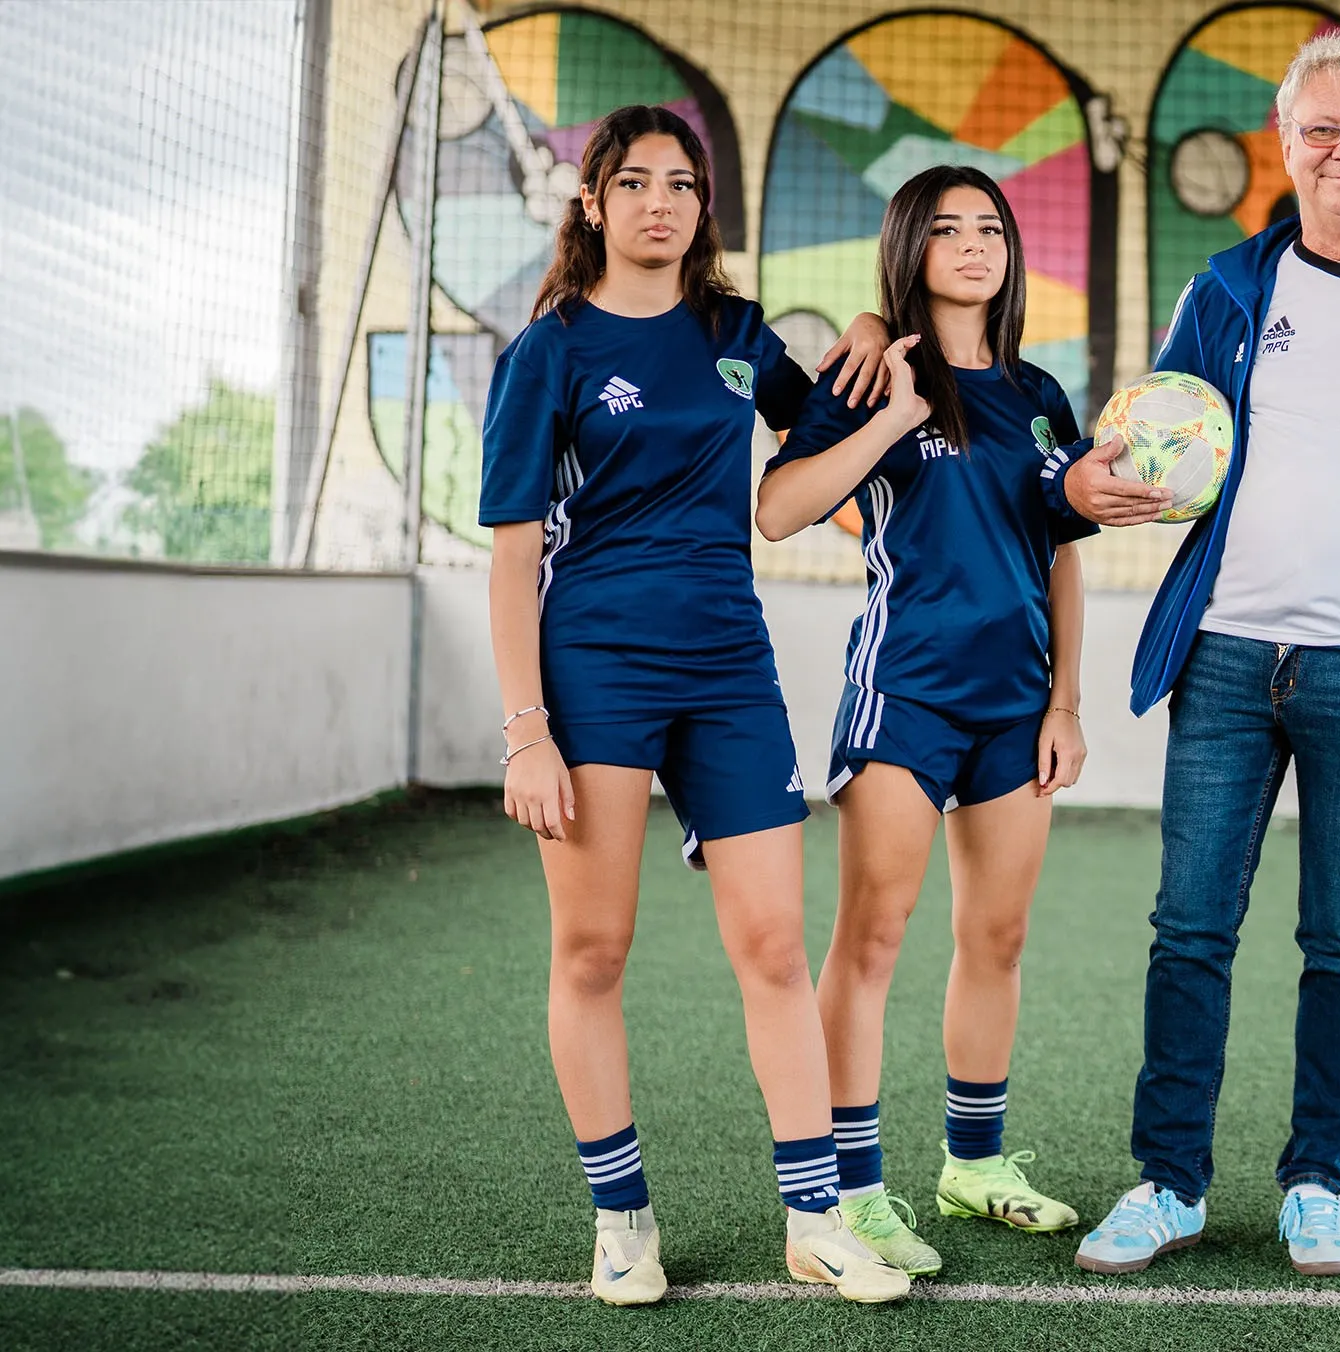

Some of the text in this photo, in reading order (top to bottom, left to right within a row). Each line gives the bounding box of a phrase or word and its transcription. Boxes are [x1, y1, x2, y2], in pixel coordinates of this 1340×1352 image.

[1262, 329, 1296, 341] adidas
[1262, 339, 1290, 355] MPG
[607, 393, 644, 416] MPG
